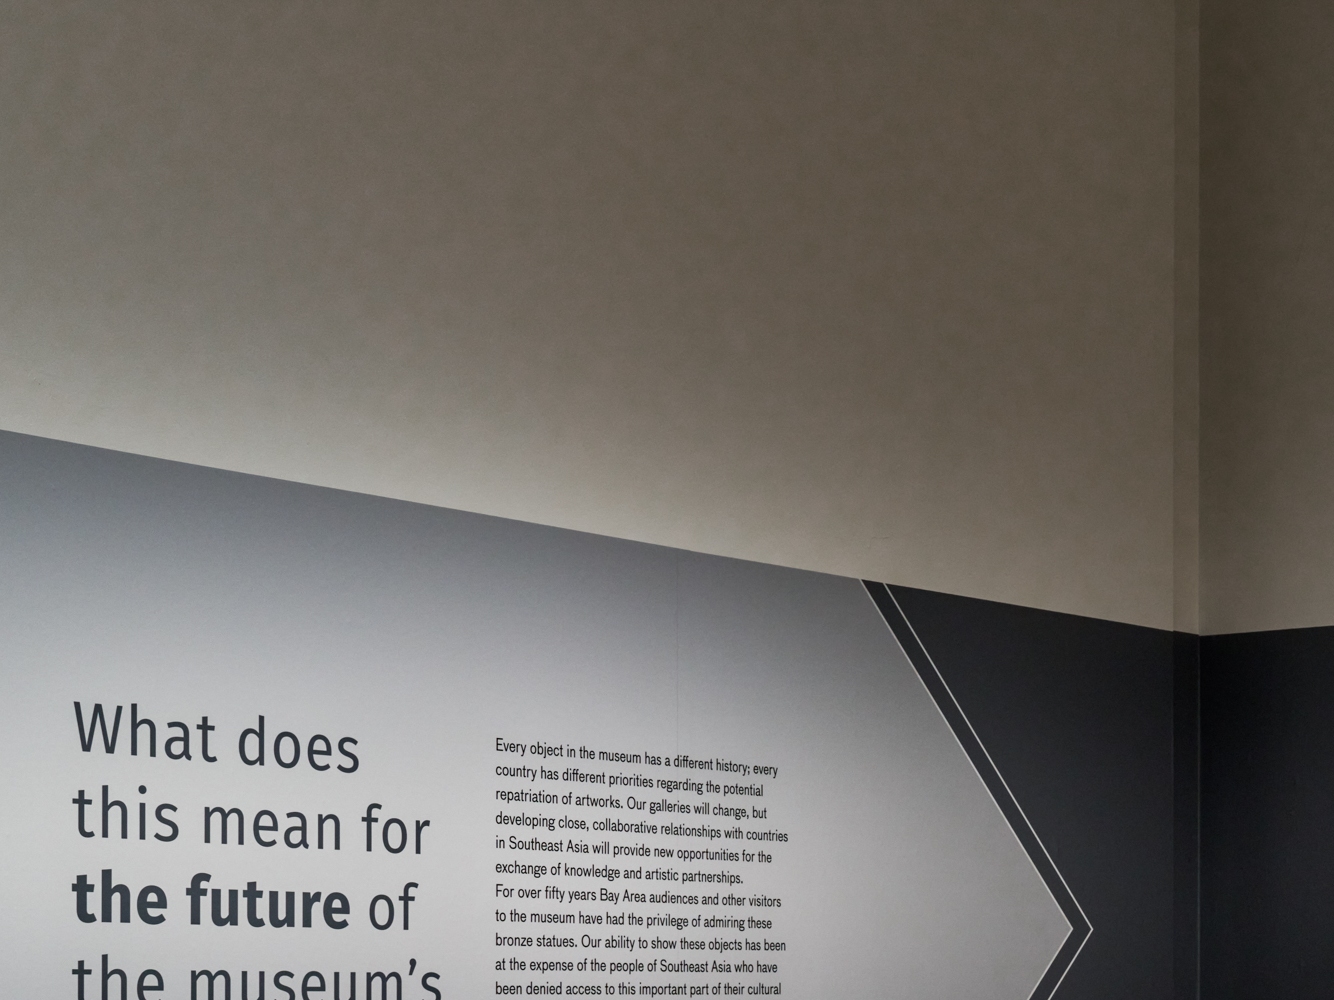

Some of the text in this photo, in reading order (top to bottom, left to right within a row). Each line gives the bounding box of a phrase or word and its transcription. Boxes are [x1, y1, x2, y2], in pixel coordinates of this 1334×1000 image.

[74, 701, 359, 774] What does
[496, 738, 778, 778] Every object in the museum has a different history; every
[496, 765, 763, 796] country has different priorities regarding the potential
[496, 789, 767, 820] repatriation of artworks. Our galleries will change, but
[72, 785, 430, 854] this mean for
[496, 811, 788, 842] developing close, collaborative relationships with countries
[496, 835, 772, 863] in Southeast Asia will provide new opportunities for the
[496, 860, 743, 886] exchange of knowledge and artistic partnerships.
[72, 869, 418, 930] the future of
[496, 884, 781, 907] For over fifty years Bay Area audiences and other visitors
[495, 908, 772, 932] to the museum have had the privilege of admiring these
[496, 932, 786, 953] bronze statues. Our ability to show these objects has been
[495, 957, 778, 974] at the expense of the people of Southeast Asia who have
[496, 981, 781, 998] been denied access to this important part of their cultural
